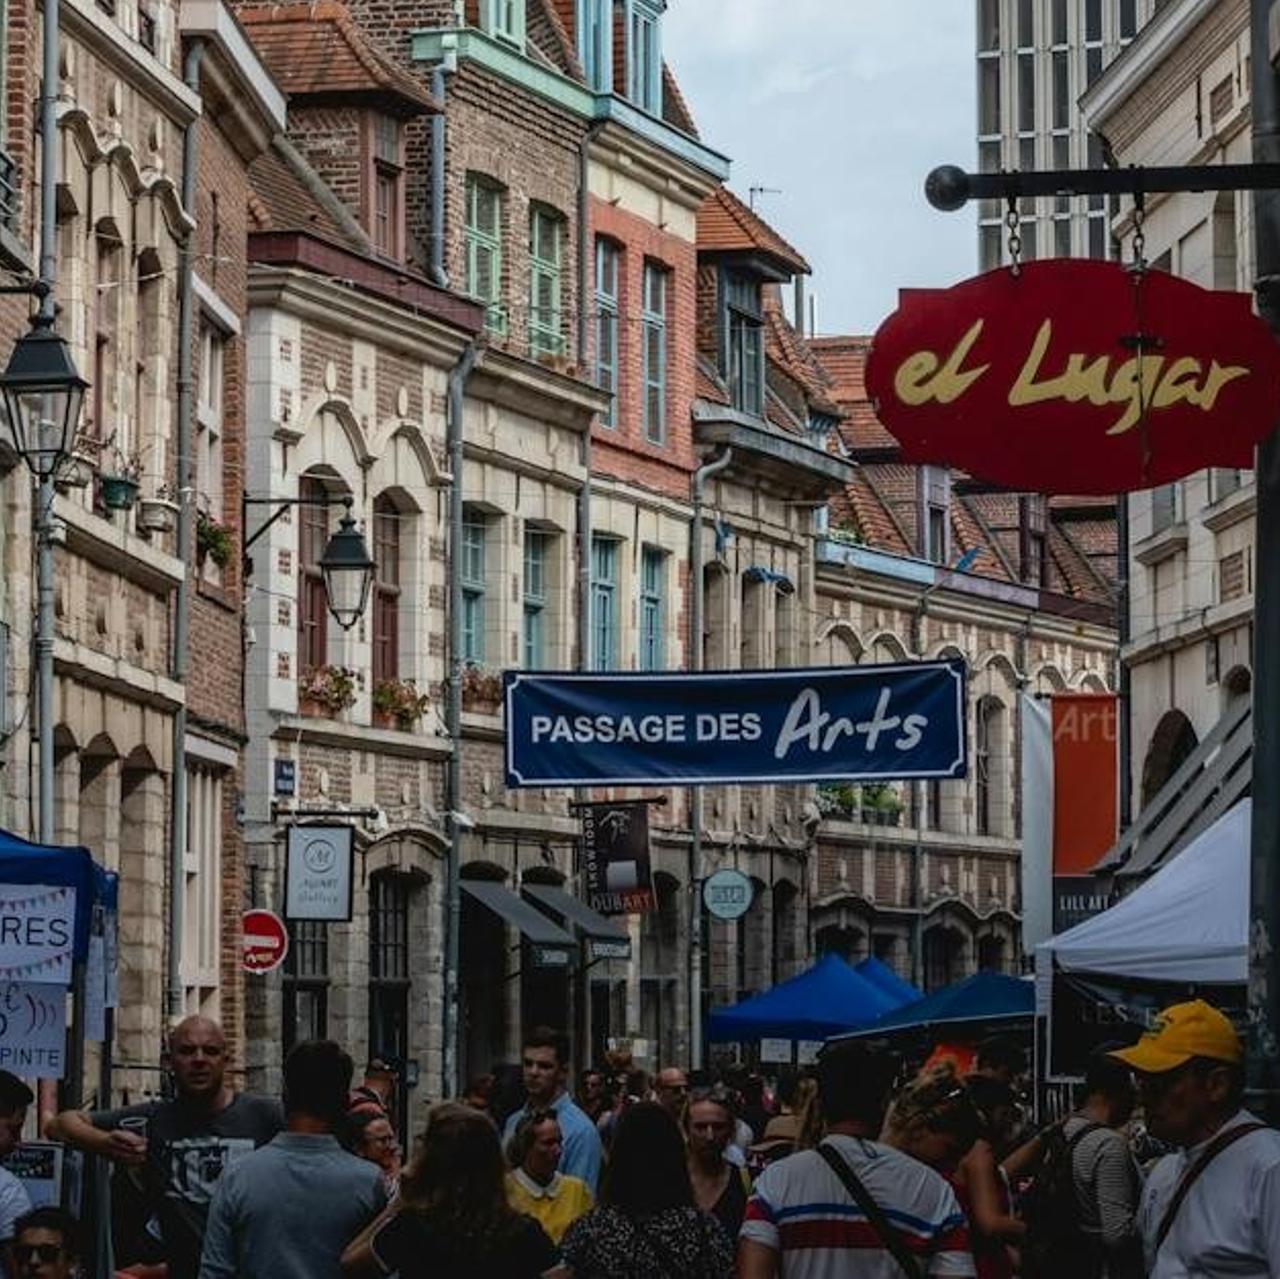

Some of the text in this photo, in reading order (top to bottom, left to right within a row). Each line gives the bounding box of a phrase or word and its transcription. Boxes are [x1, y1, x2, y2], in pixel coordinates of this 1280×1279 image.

[892, 318, 1252, 436] el Lugar
[531, 686, 930, 760] PASSAGE DES Arts
[1055, 706, 1117, 743] Art
[0, 1047, 60, 1067] PINTE
